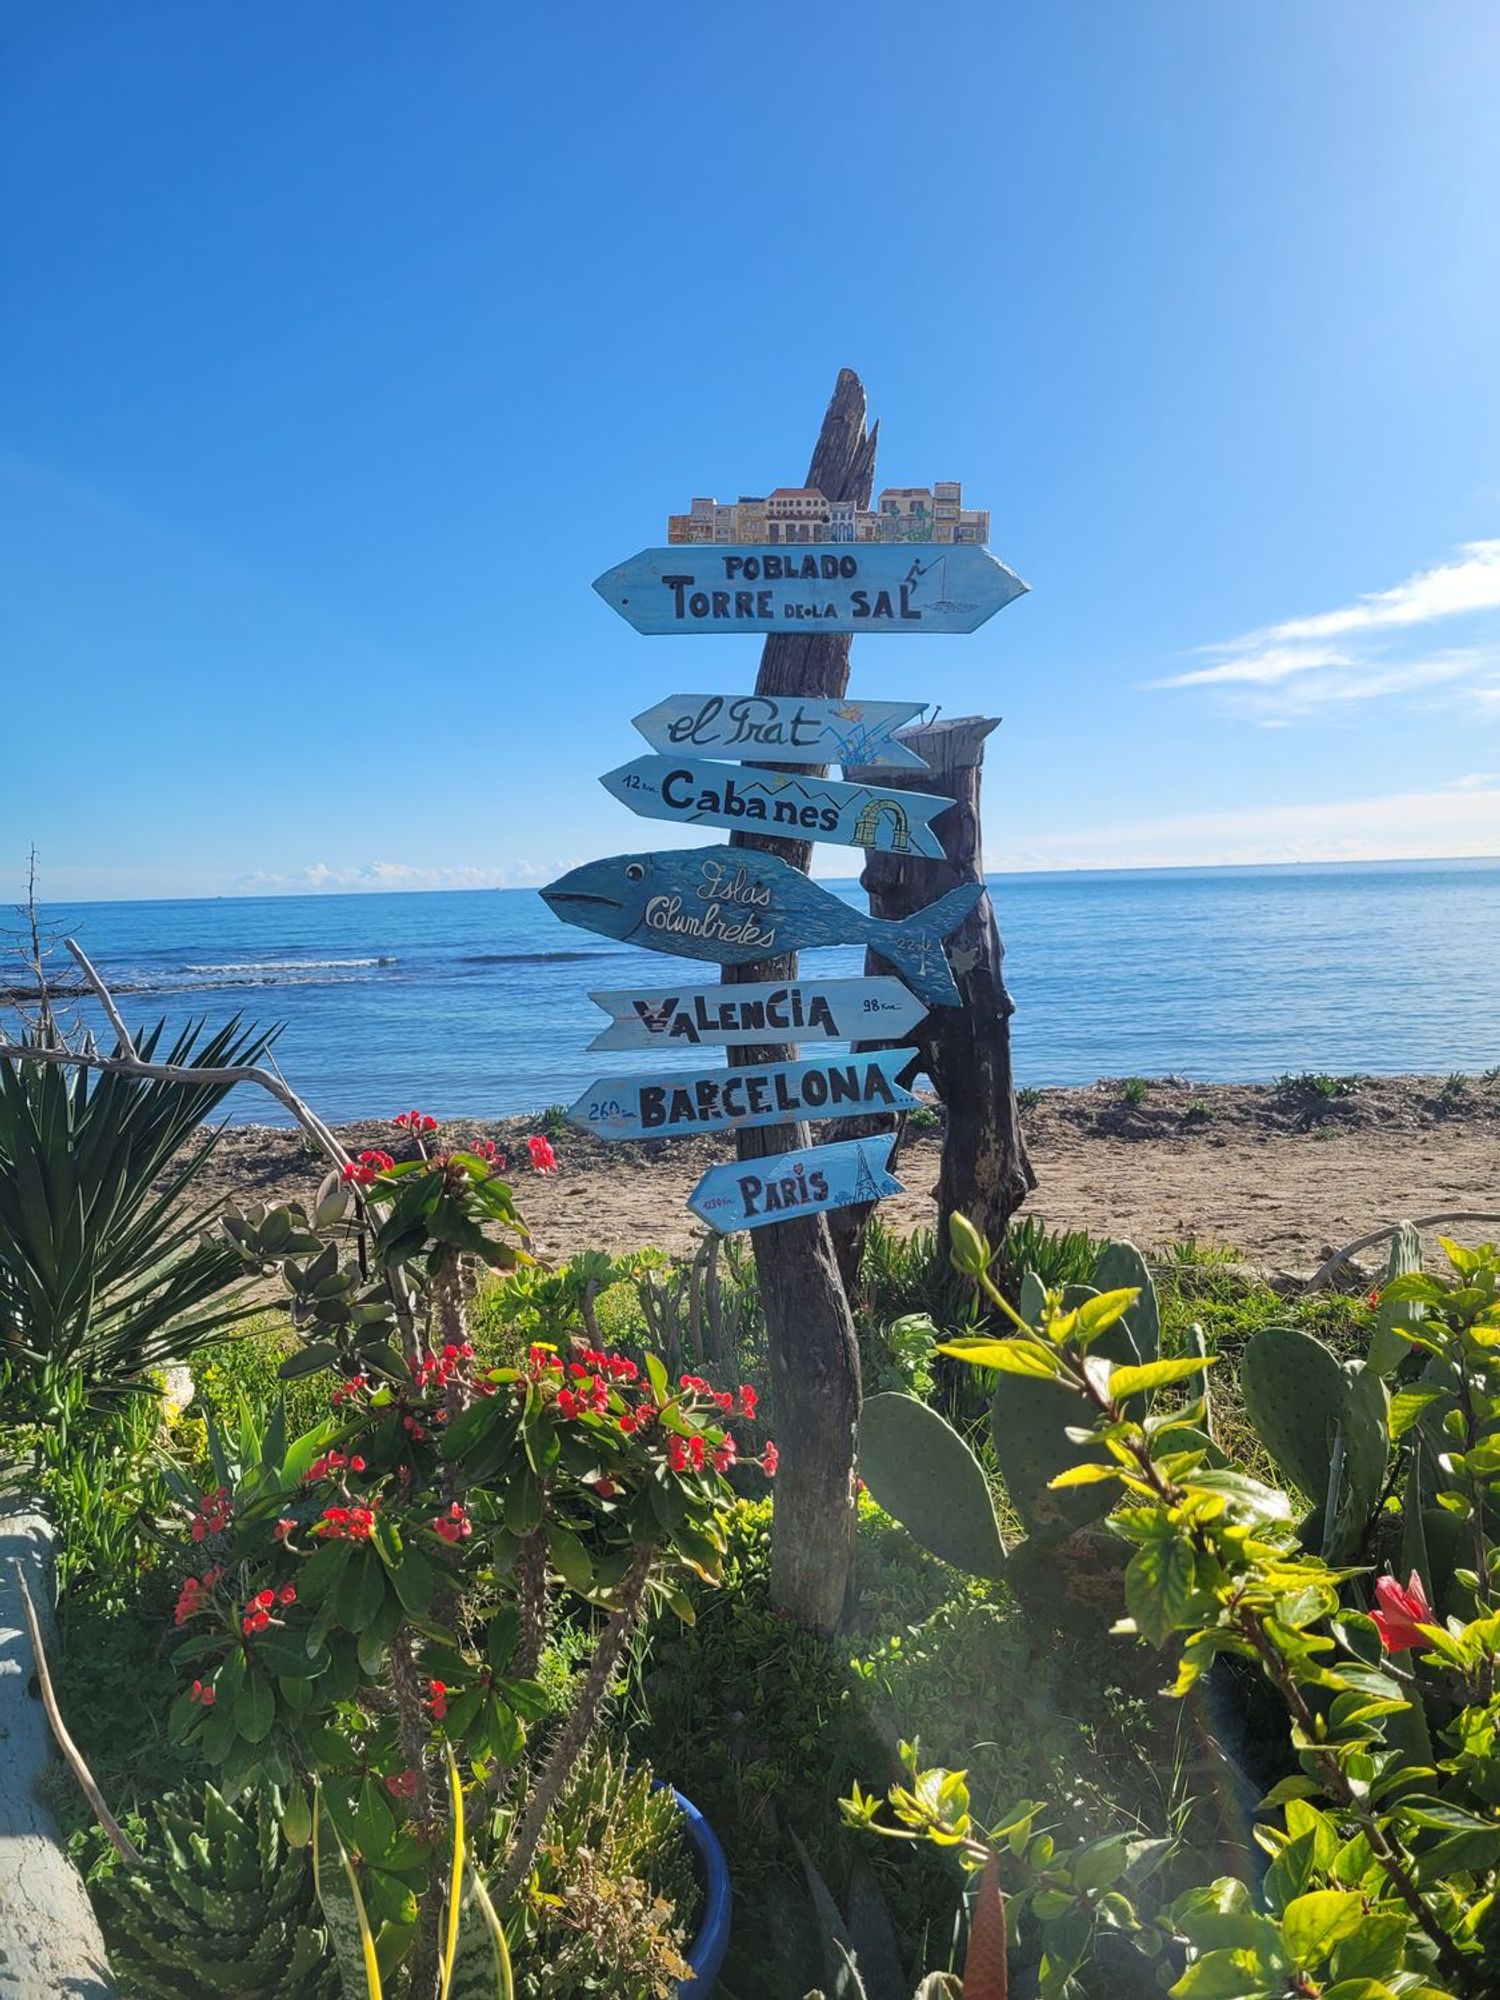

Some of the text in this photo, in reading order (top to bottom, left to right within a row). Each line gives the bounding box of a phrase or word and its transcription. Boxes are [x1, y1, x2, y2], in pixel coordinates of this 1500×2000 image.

[721, 555, 858, 580] POBLADO
[661, 575, 775, 620] TORRE
[851, 583, 922, 620] SAL
[667, 696, 822, 746] el Prat
[622, 774, 641, 789] 12
[661, 769, 840, 832] Cabanes
[696, 860, 771, 906] Islas
[645, 896, 776, 948] Columbretes
[632, 988, 840, 1044] VALENCIA
[863, 998, 880, 1012] 98
[639, 1062, 896, 1129] BARCELONA
